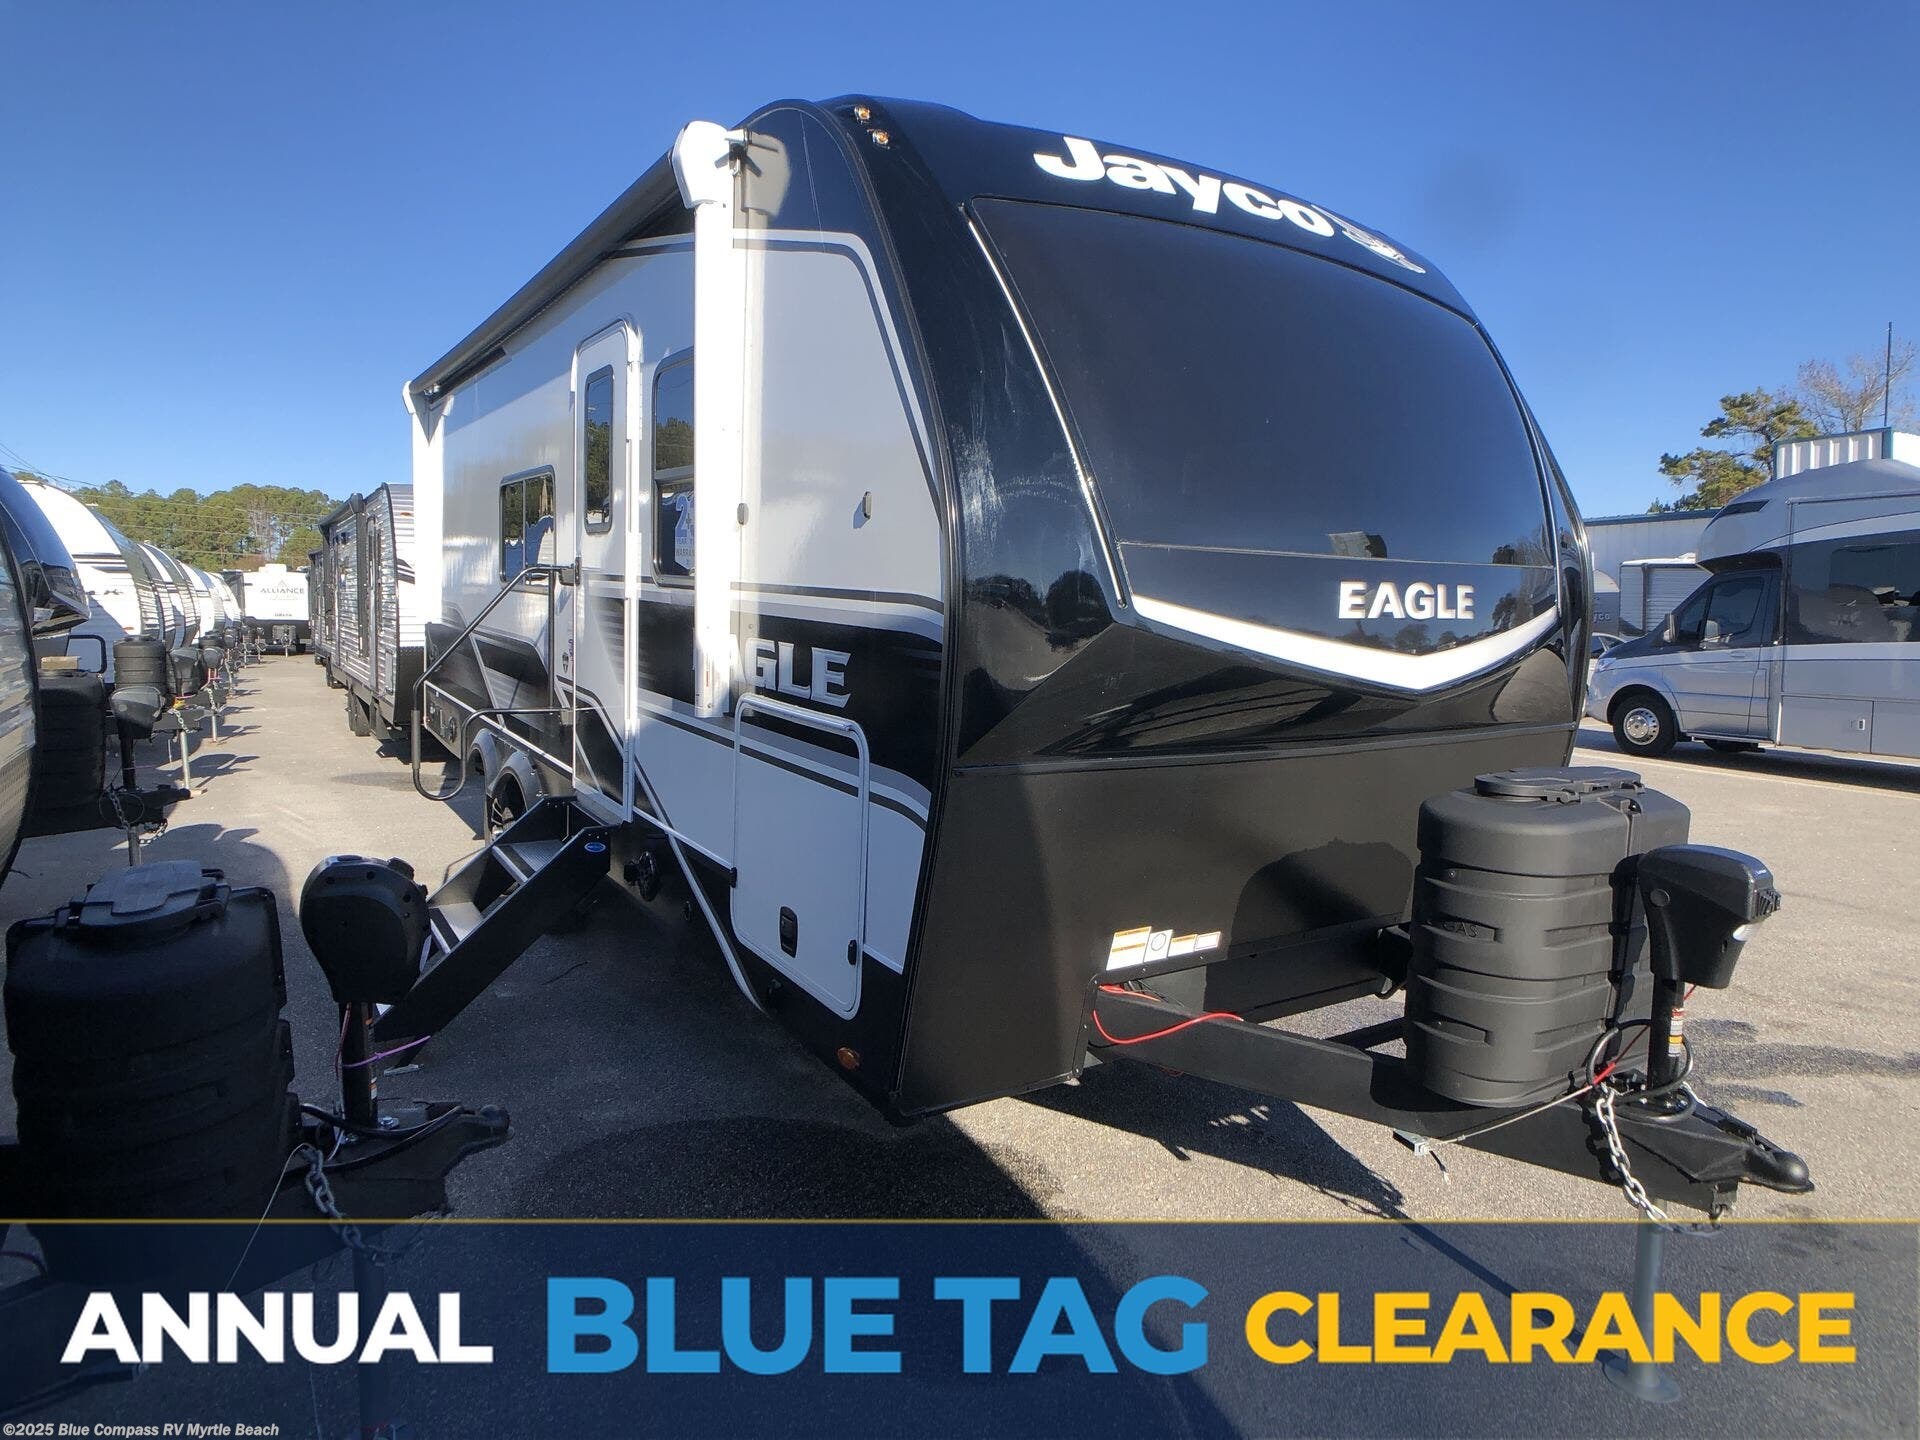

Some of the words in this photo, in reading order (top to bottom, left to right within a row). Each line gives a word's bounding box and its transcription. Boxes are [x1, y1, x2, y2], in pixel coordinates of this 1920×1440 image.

[1034, 136, 1334, 237] Jayco
[1338, 581, 1474, 620] EAGLE
[745, 637, 851, 708] GLE
